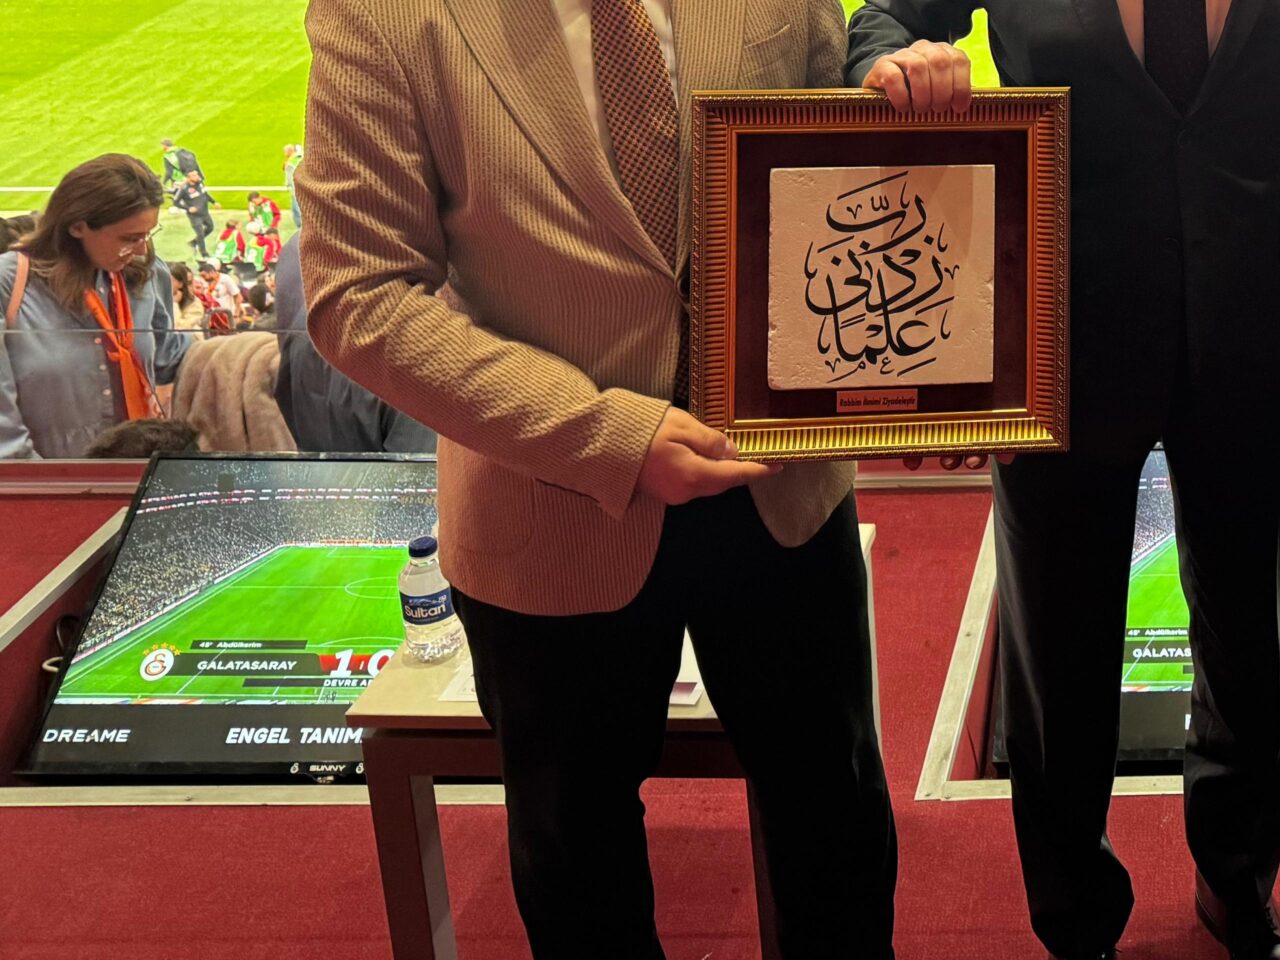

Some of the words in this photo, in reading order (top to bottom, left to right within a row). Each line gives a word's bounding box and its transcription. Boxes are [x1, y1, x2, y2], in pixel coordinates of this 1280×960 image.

[404, 604, 446, 618] Sultan
[1132, 648, 1192, 658] GALATAS
[196, 660, 298, 671] GALATASARAY
[329, 648, 353, 677] 1
[323, 679, 357, 687] DEVRE
[42, 729, 131, 743] DREAME
[225, 727, 290, 744] ENGEL
[299, 727, 363, 744] TANIM
